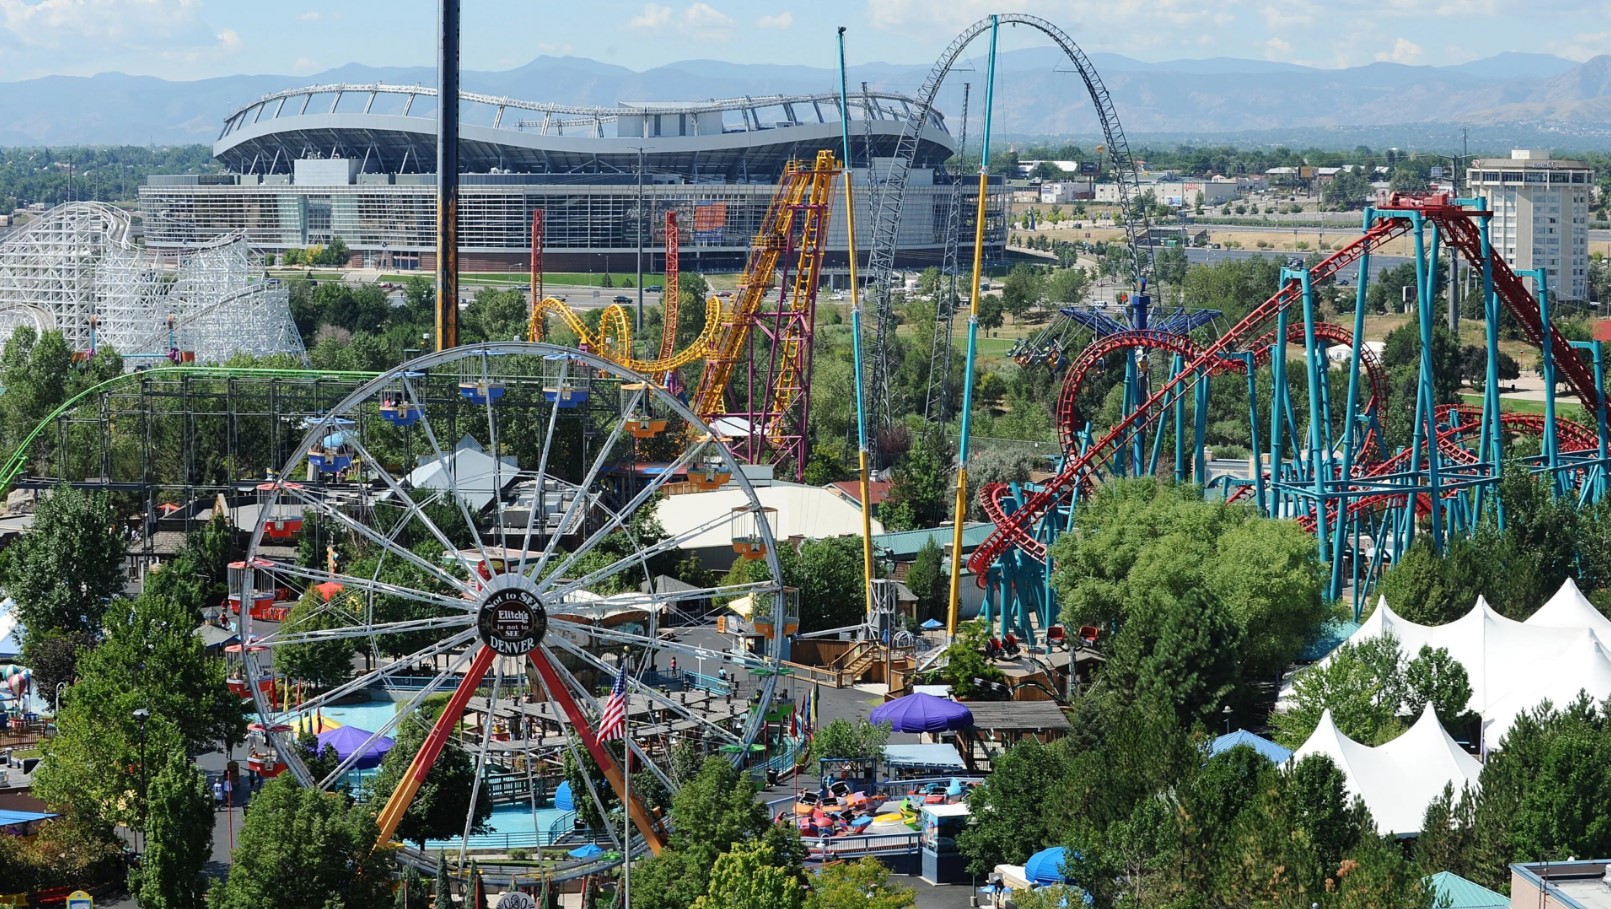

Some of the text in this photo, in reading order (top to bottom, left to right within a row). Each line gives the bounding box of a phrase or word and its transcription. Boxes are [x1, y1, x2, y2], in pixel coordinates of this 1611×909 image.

[484, 596, 503, 612] Not
[519, 592, 542, 613] SEE
[498, 610, 529, 620] Elitch's
[490, 635, 535, 654] DENVER
